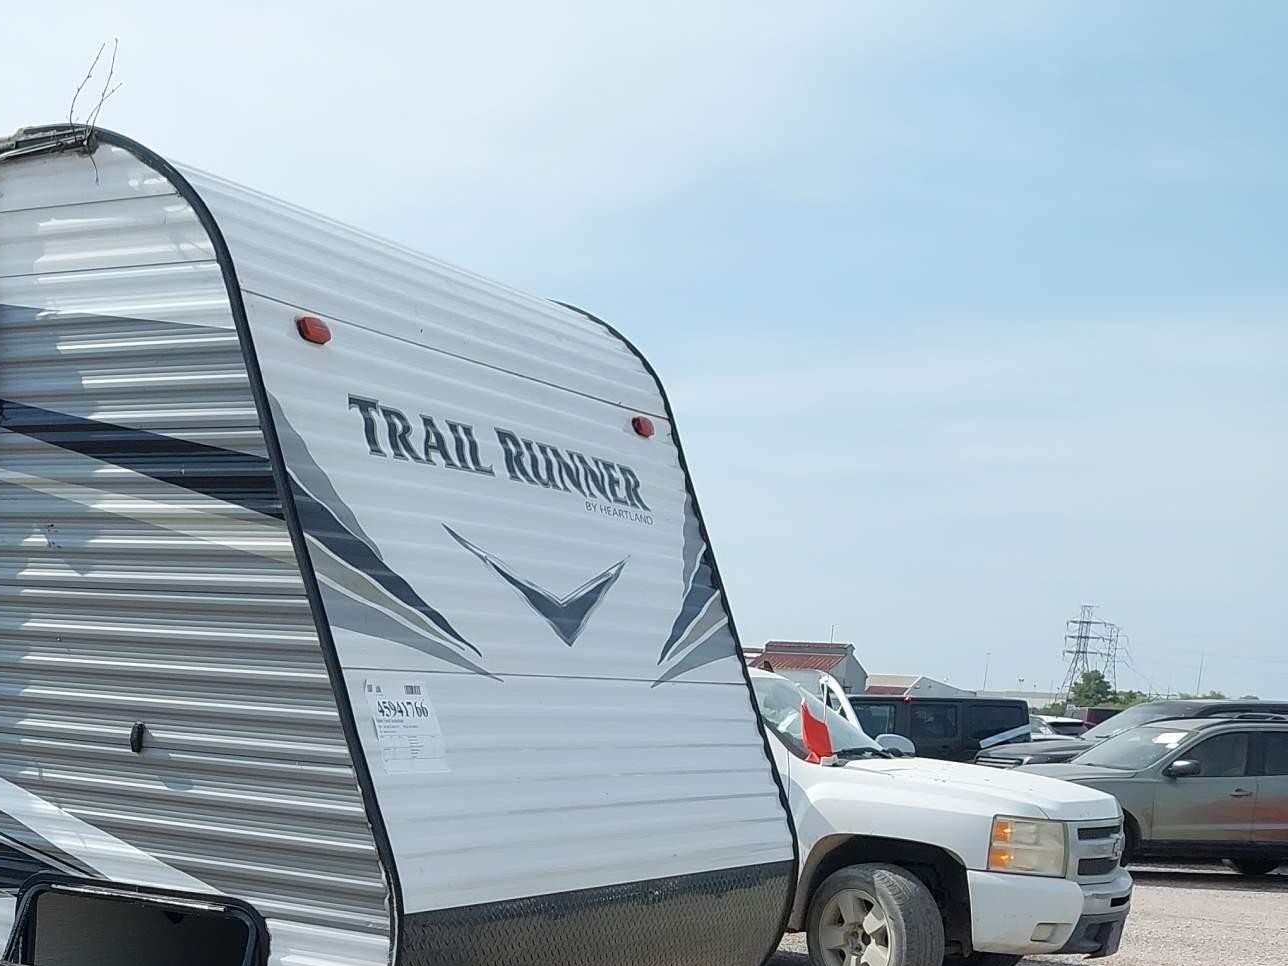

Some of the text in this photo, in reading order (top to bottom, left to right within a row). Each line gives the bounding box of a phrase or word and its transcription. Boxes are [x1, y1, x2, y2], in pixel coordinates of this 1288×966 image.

[347, 393, 652, 512] TRAIL RUNNER
[585, 501, 654, 526] BY HEARTLAND
[377, 700, 429, 718] 45941766
